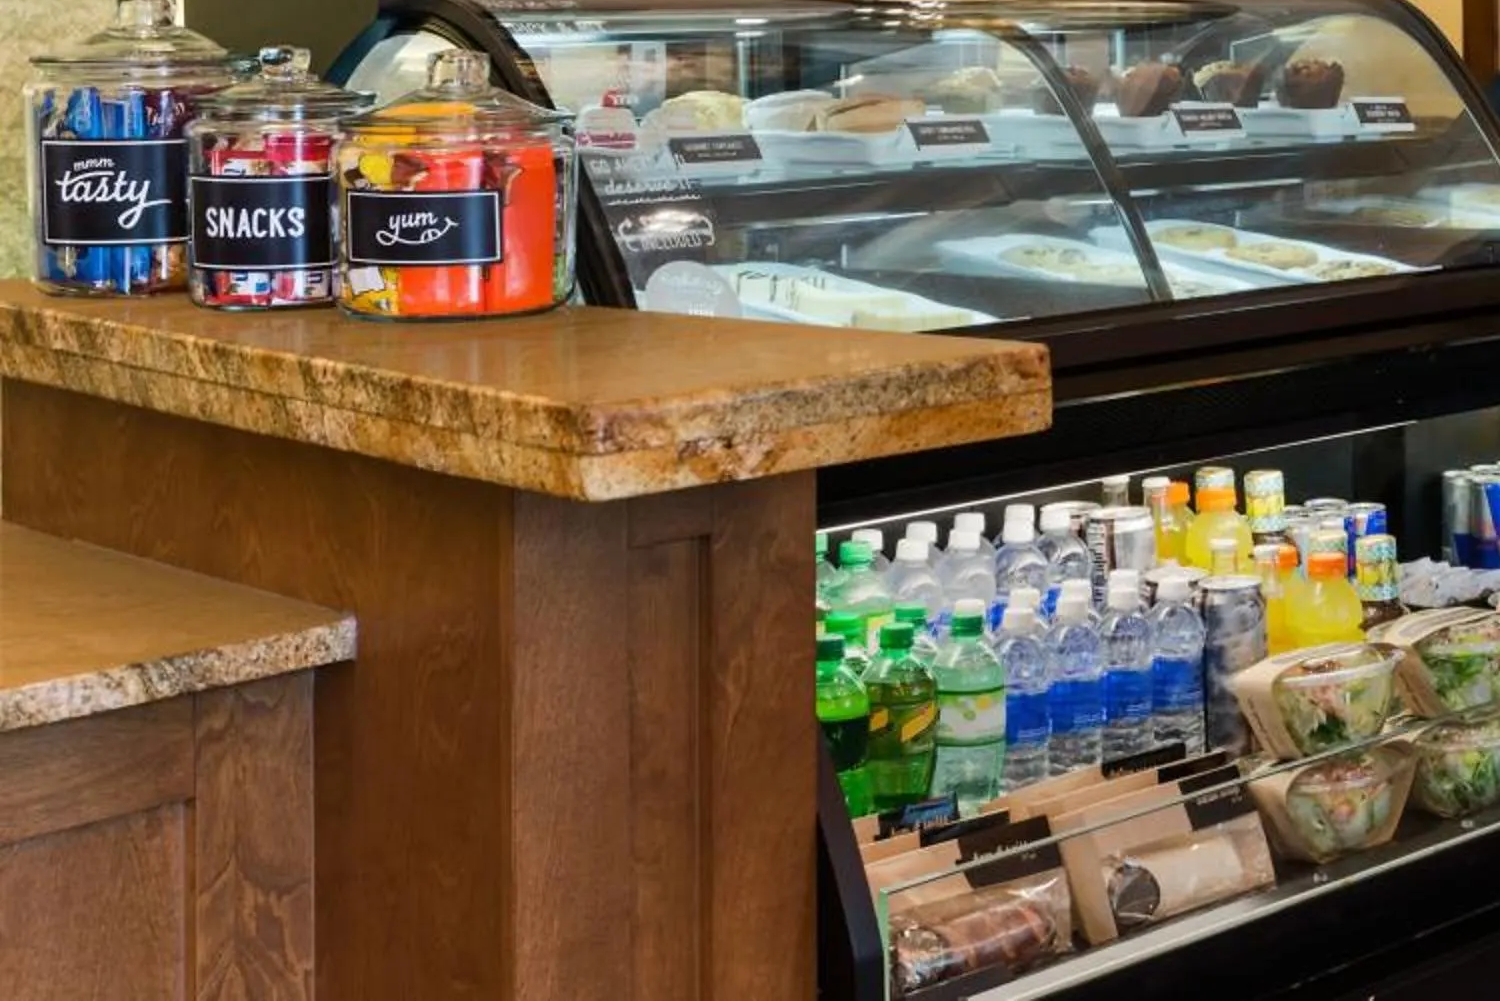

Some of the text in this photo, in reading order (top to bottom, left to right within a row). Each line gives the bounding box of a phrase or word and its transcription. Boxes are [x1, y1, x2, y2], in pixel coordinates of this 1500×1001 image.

[55, 170, 172, 229] tasty
[205, 206, 305, 239] SNACKS
[376, 212, 440, 246] yum
